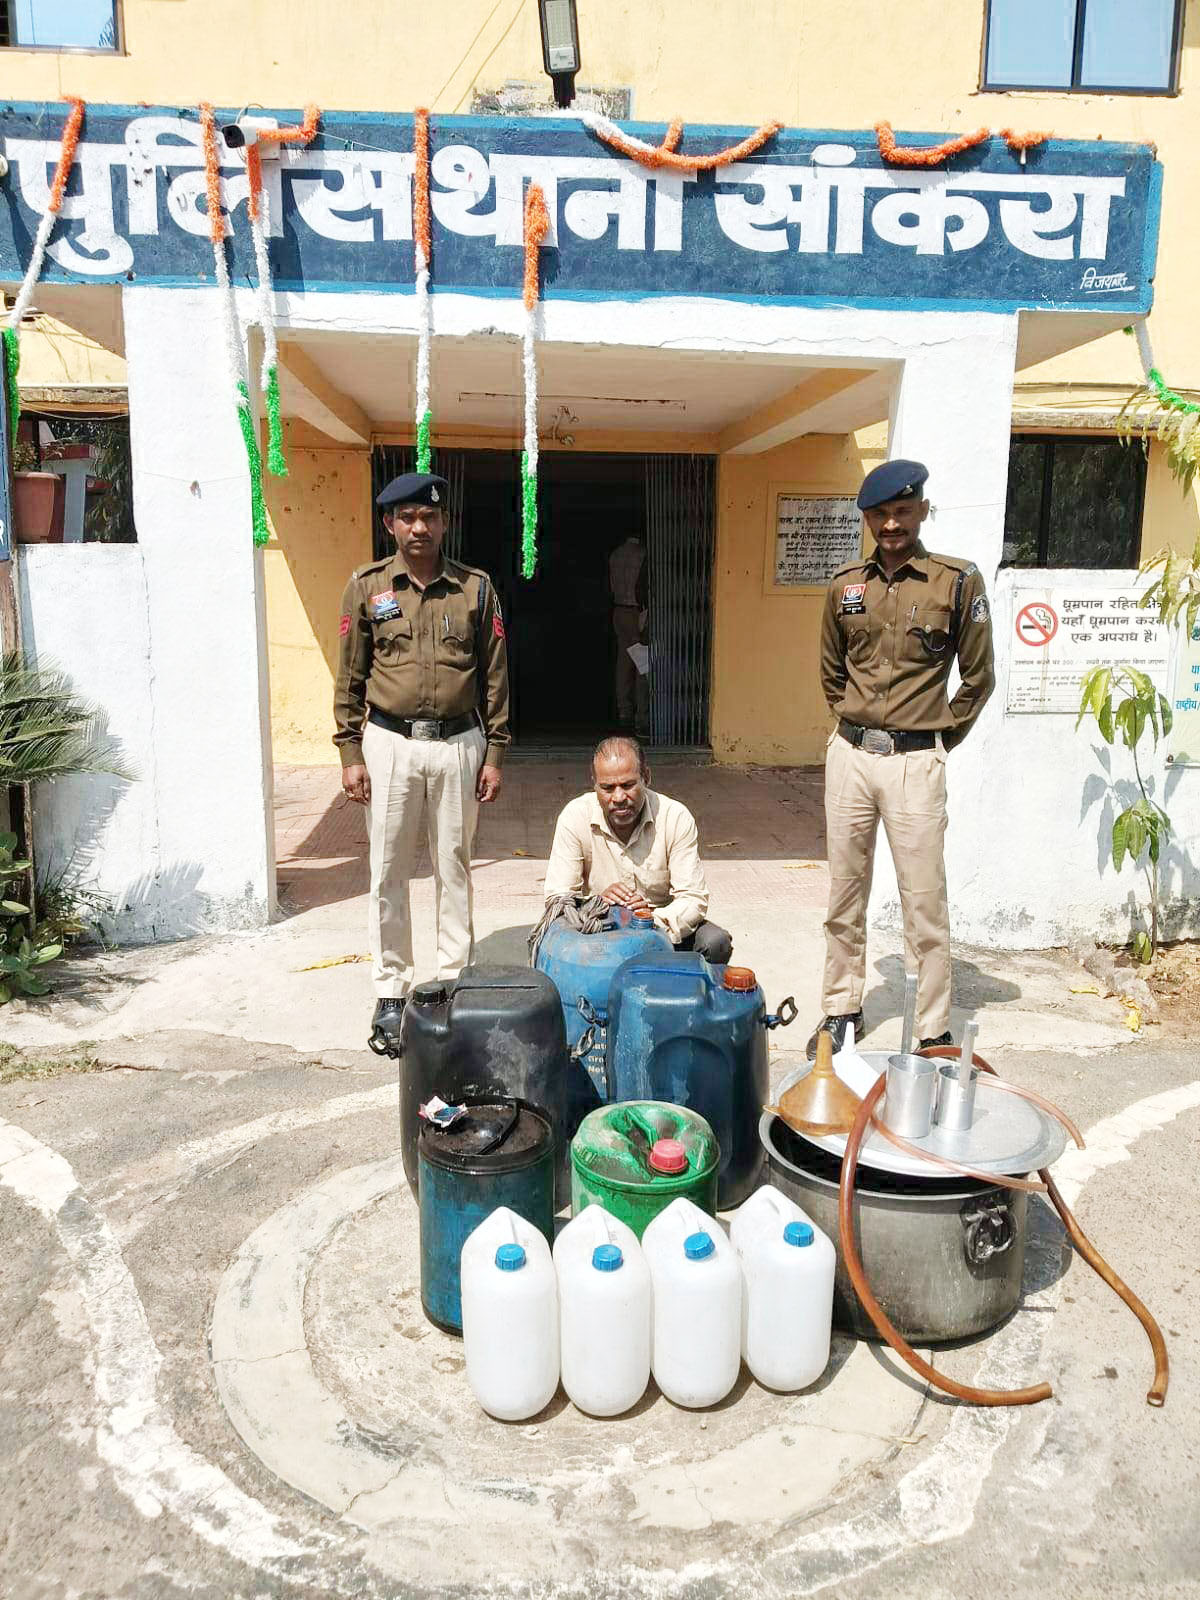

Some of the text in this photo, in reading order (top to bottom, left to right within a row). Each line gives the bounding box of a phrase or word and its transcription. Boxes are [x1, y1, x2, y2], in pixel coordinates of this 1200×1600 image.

[4, 116, 1126, 276] पुलिस थाना सांकरा
[1109, 596, 1139, 610] रहित
[1061, 614, 1085, 627] यहाँ
[1135, 616, 1167, 626] करन
[1071, 633, 1093, 644] एक
[1098, 632, 1139, 642] अपराध
